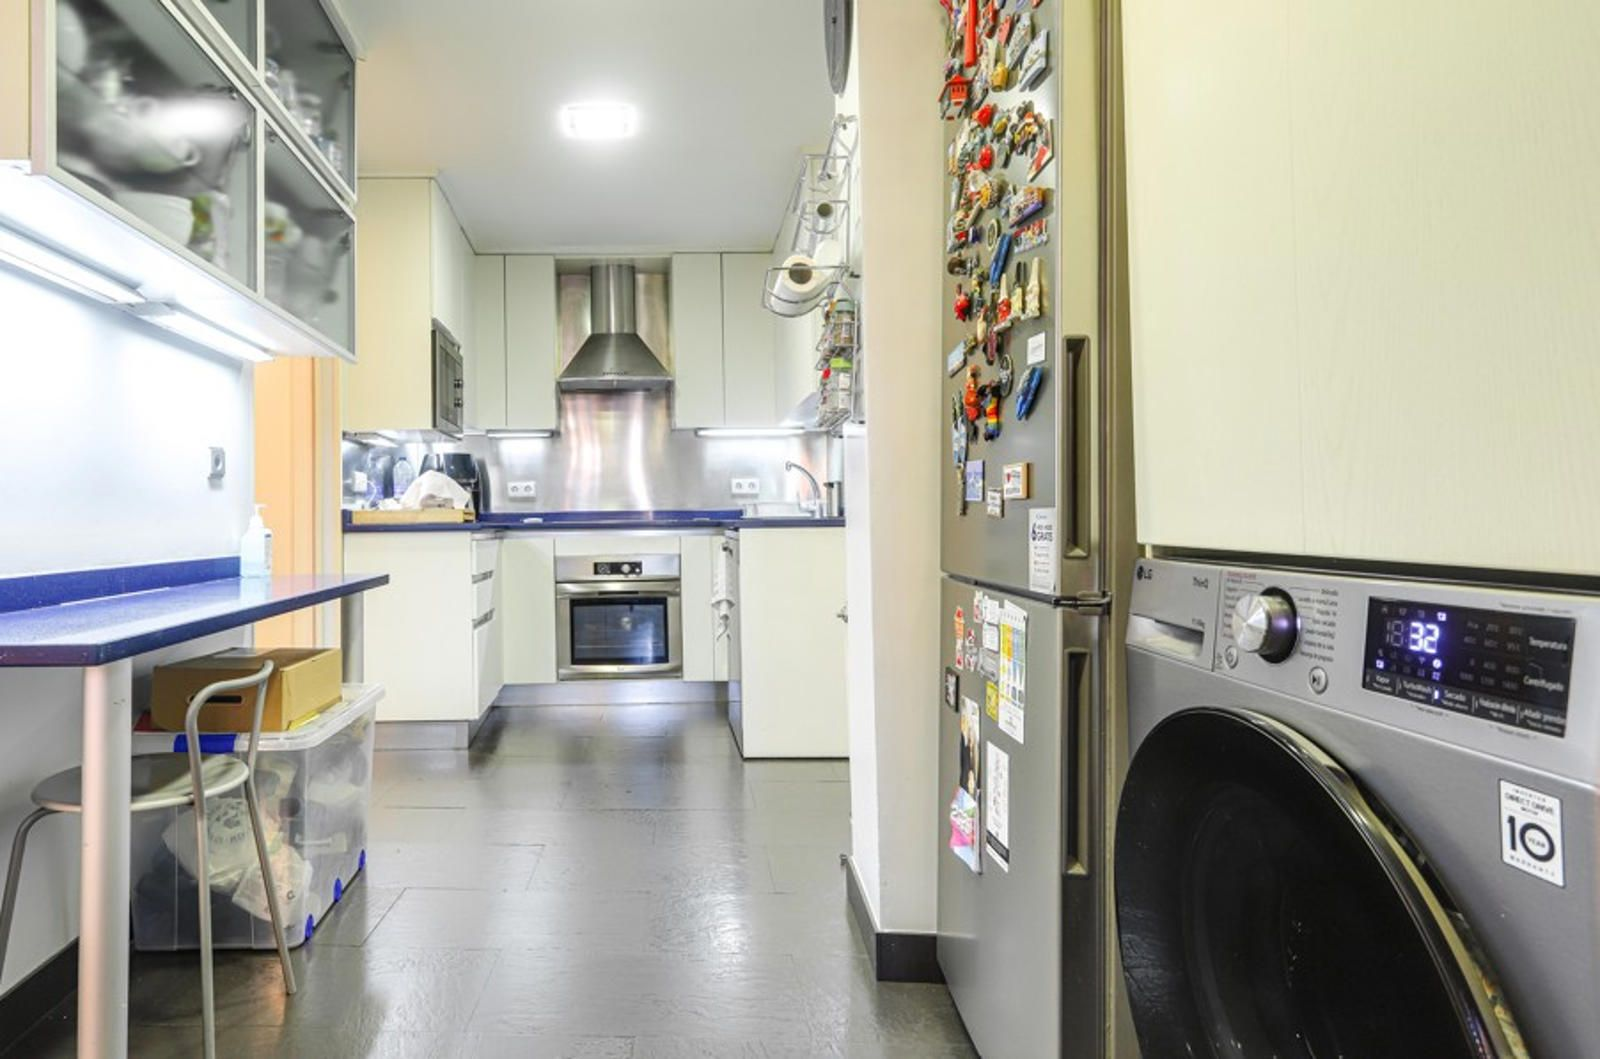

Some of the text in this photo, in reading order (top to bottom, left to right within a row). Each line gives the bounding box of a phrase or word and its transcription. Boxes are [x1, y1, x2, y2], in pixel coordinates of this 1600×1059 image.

[1409, 621, 1440, 655] 32
[1528, 636, 1568, 651] Temperatura
[1523, 674, 1565, 692] Centrifugado
[1507, 815, 1555, 863] 10
